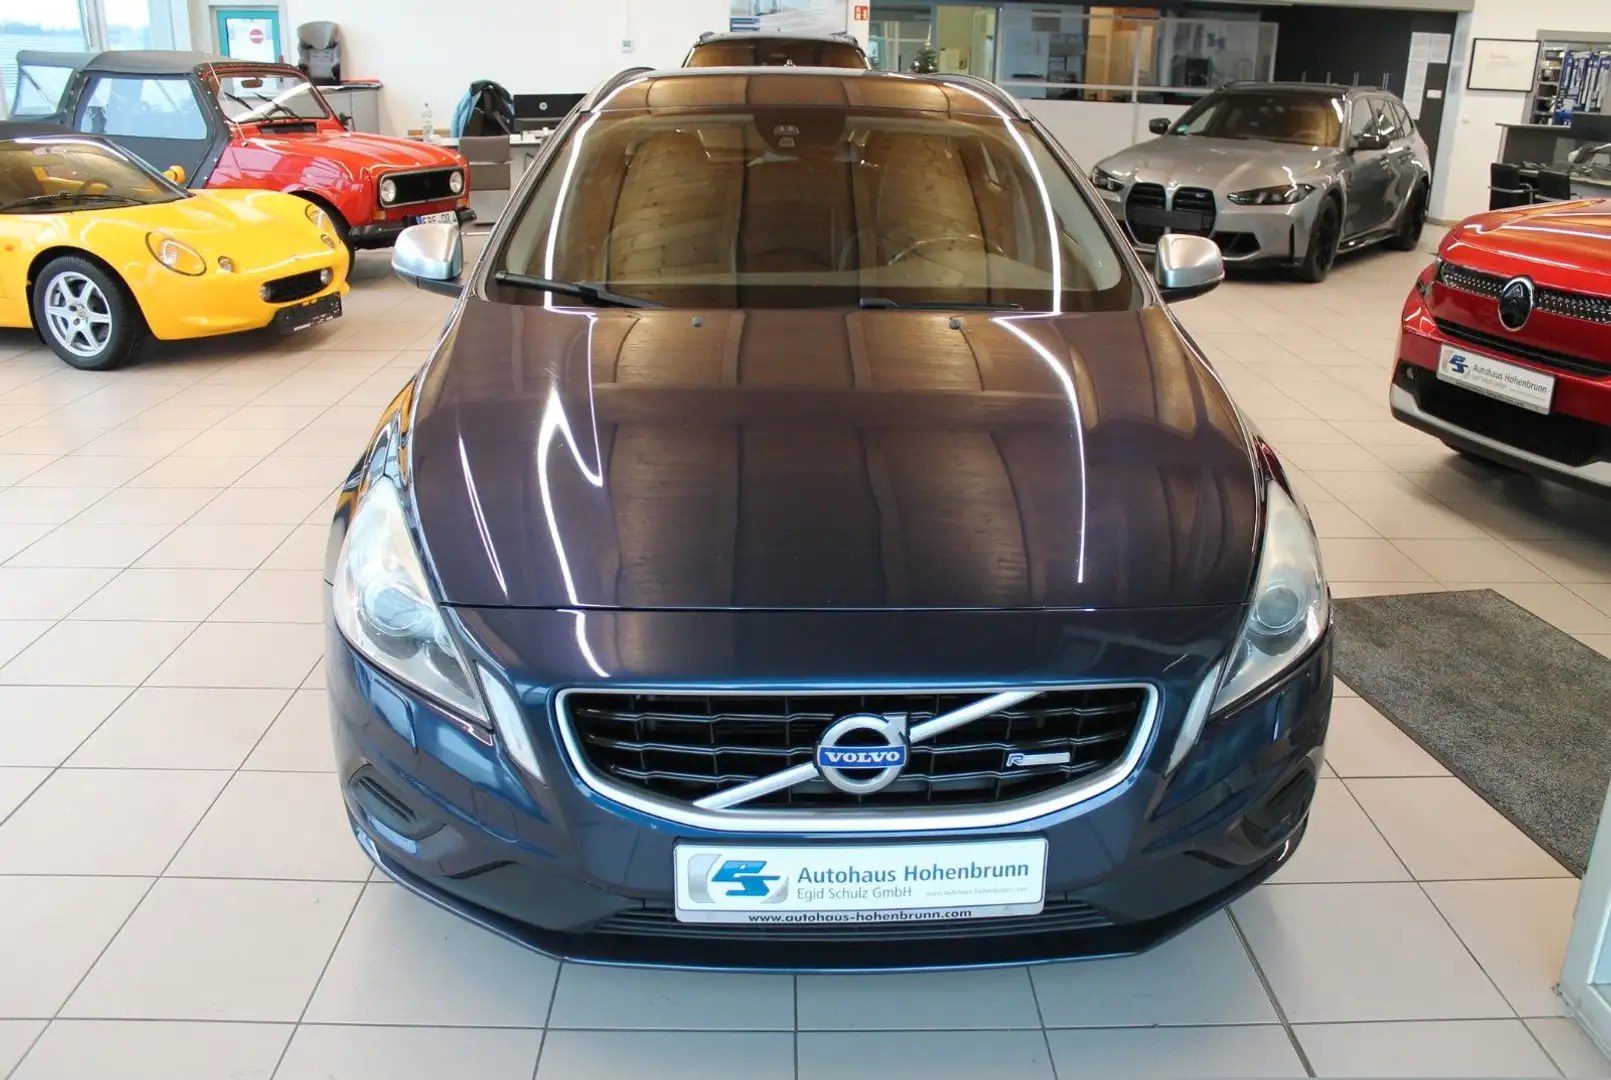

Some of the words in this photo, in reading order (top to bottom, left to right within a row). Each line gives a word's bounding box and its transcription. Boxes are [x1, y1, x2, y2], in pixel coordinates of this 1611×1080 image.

[1473, 364, 1503, 379] Autohaus
[1504, 373, 1547, 393] Hohenbrunn
[824, 751, 900, 763] VOLVO
[797, 866, 896, 883] Autohaus
[904, 861, 1029, 881] Hohenbrunn
[797, 887, 824, 902] Egid
[828, 887, 868, 899] Schulz
[872, 885, 912, 899] GmbH
[748, 910, 972, 922] www.autohaus-hohenbrunn.com
